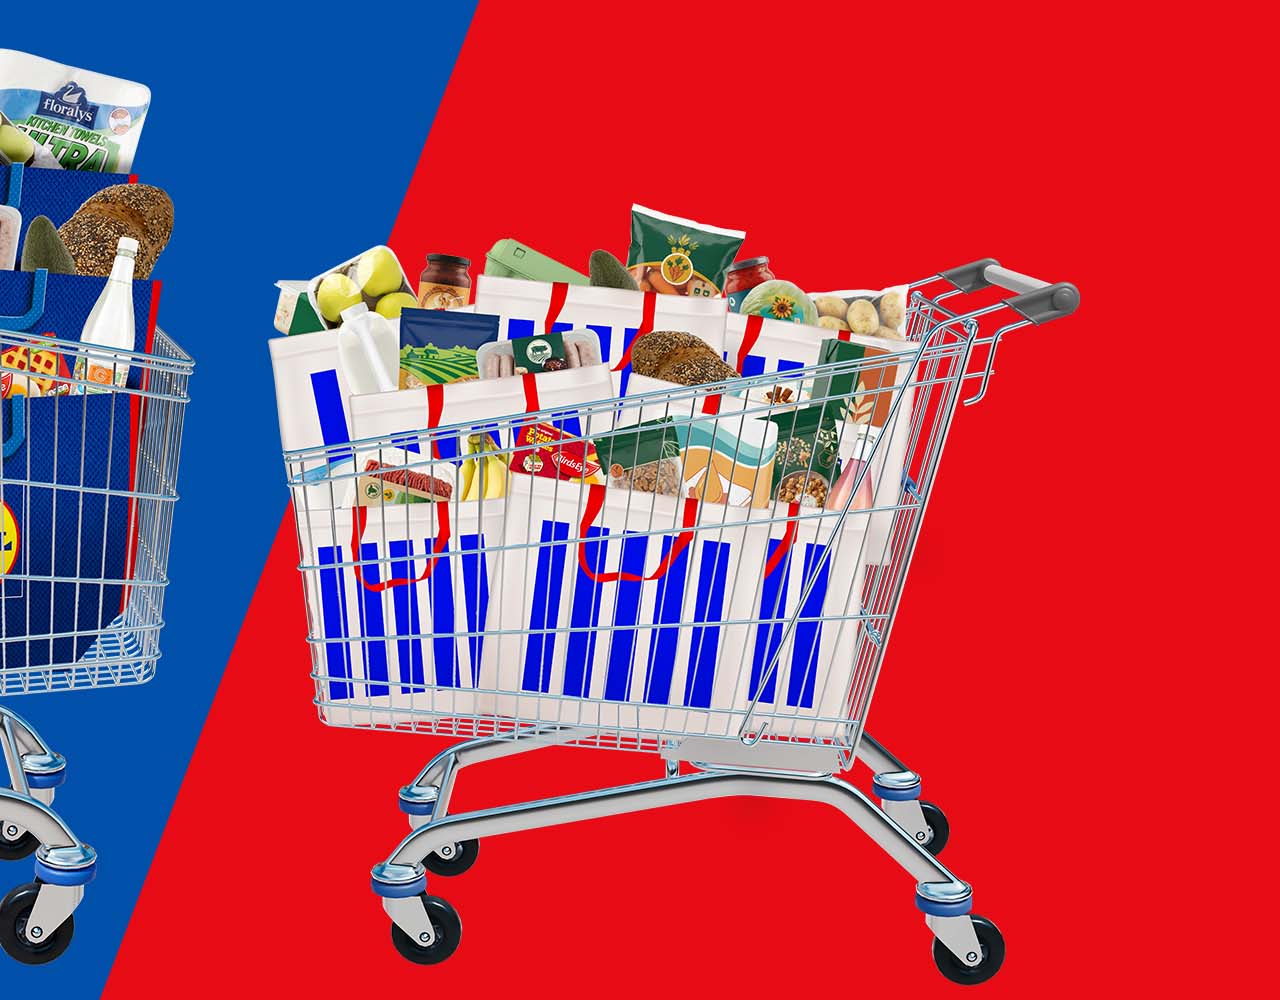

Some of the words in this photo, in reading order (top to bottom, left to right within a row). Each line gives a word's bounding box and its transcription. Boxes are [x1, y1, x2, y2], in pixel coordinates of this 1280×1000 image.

[44, 98, 93, 123] floralys
[26, 115, 68, 136] KITCHEN
[70, 126, 108, 147] TOWELS
